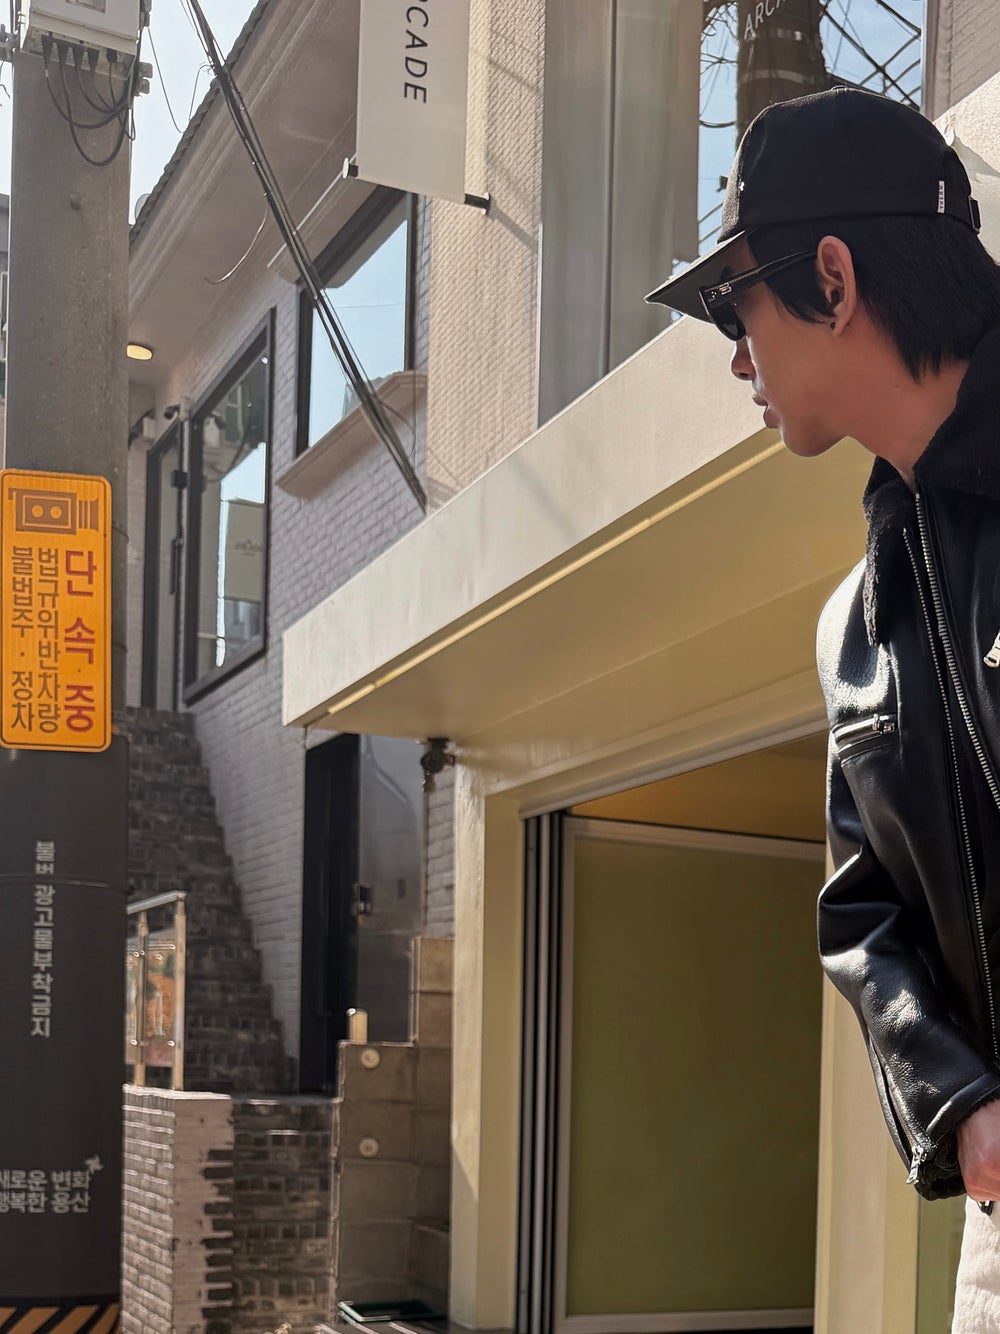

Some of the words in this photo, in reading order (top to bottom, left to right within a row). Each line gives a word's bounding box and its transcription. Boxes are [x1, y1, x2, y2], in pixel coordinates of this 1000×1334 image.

[404, 0, 429, 104] CADE
[37, 548, 61, 734] 법규위반차량
[51, 1169, 91, 1191] 변화
[51, 1191, 91, 1214] 용산
